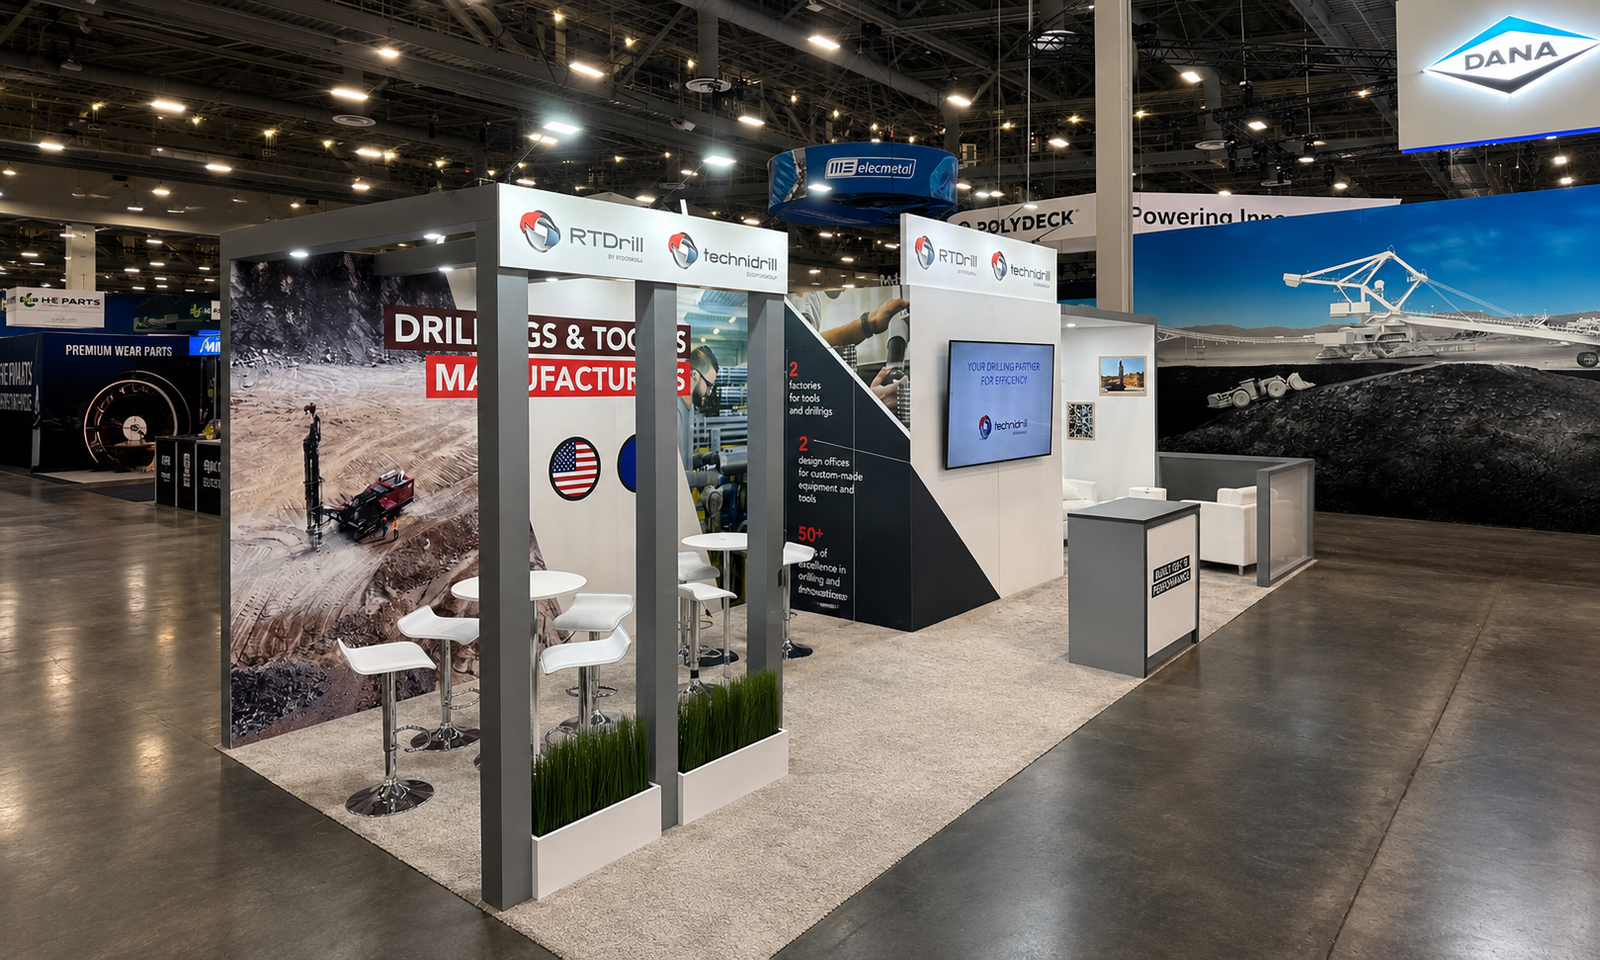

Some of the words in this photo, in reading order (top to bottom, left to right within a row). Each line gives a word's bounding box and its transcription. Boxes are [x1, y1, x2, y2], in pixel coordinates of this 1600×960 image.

[1465, 41, 1559, 71] DANA
[857, 160, 913, 175] elecmetal
[977, 210, 1074, 234] POLYDECK
[570, 227, 643, 252] RTDrill
[704, 248, 777, 271] technidrill
[939, 248, 977, 268] RTDrill
[1011, 264, 1050, 282] technidrill
[62, 298, 100, 306] PARTS
[566, 324, 585, 350] &
[66, 344, 112, 356] PREMIUM
[115, 345, 142, 357] WEAR
[144, 346, 172, 357] PARTS
[789, 361, 798, 377] 2
[967, 362, 986, 372] YOUR
[986, 362, 1014, 371] DRILLING
[789, 380, 821, 390] factories
[981, 376, 994, 386] FOR
[789, 392, 800, 402] for
[801, 393, 820, 402] tools
[789, 406, 803, 415] and
[994, 419, 1028, 431] technidrill
[798, 436, 808, 452] 2
[798, 455, 822, 468] design
[824, 456, 850, 468] offices
[798, 467, 808, 478] for
[810, 469, 863, 481] custom-made
[798, 481, 838, 494] equipment
[840, 484, 854, 494] and
[798, 494, 817, 503] tools
[798, 525, 824, 542] 50+
[820, 548, 828, 558] of
[839, 564, 846, 574] in
[825, 576, 840, 587] and
